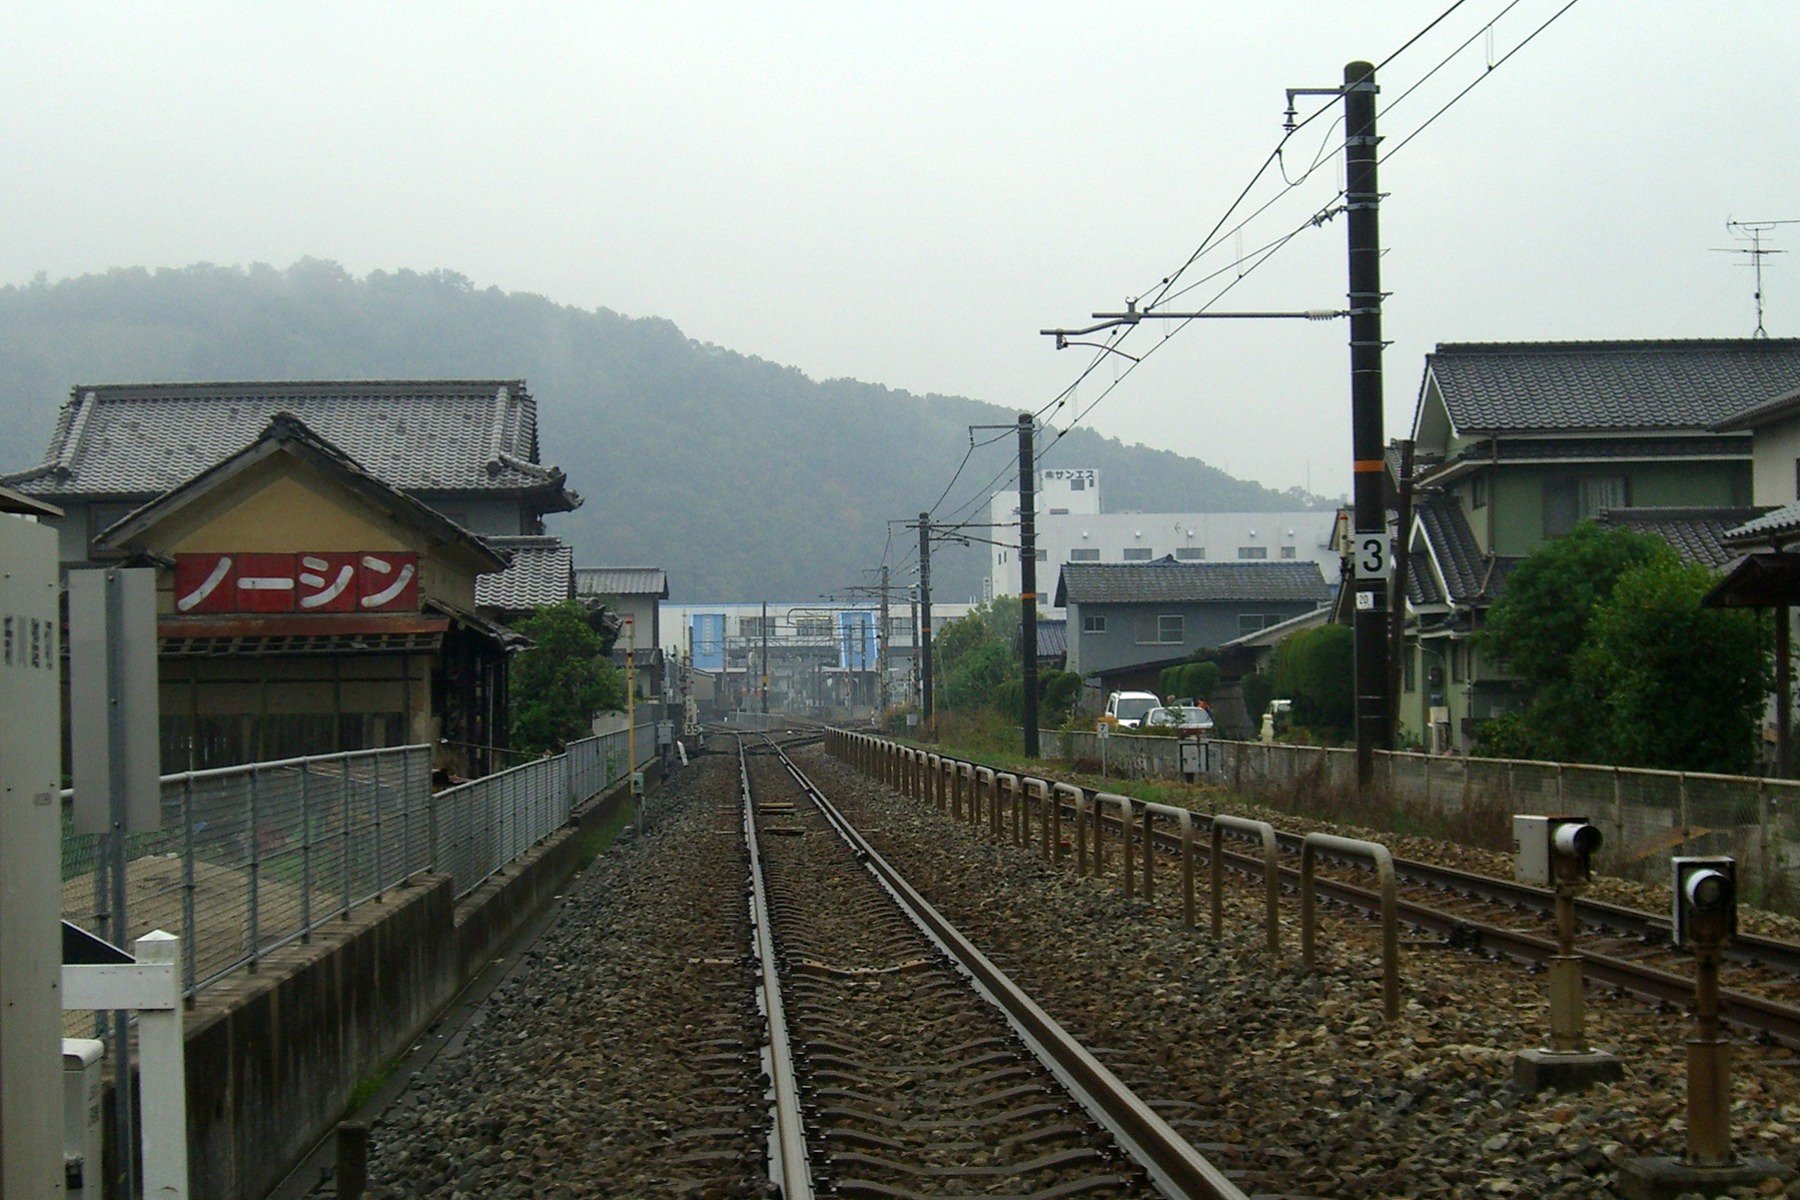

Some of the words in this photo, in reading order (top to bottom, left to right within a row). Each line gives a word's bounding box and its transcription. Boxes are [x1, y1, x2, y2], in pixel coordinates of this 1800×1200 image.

[1363, 539, 1382, 572] 3
[178, 556, 415, 611] ノーシン
[687, 724, 699, 734] 35
